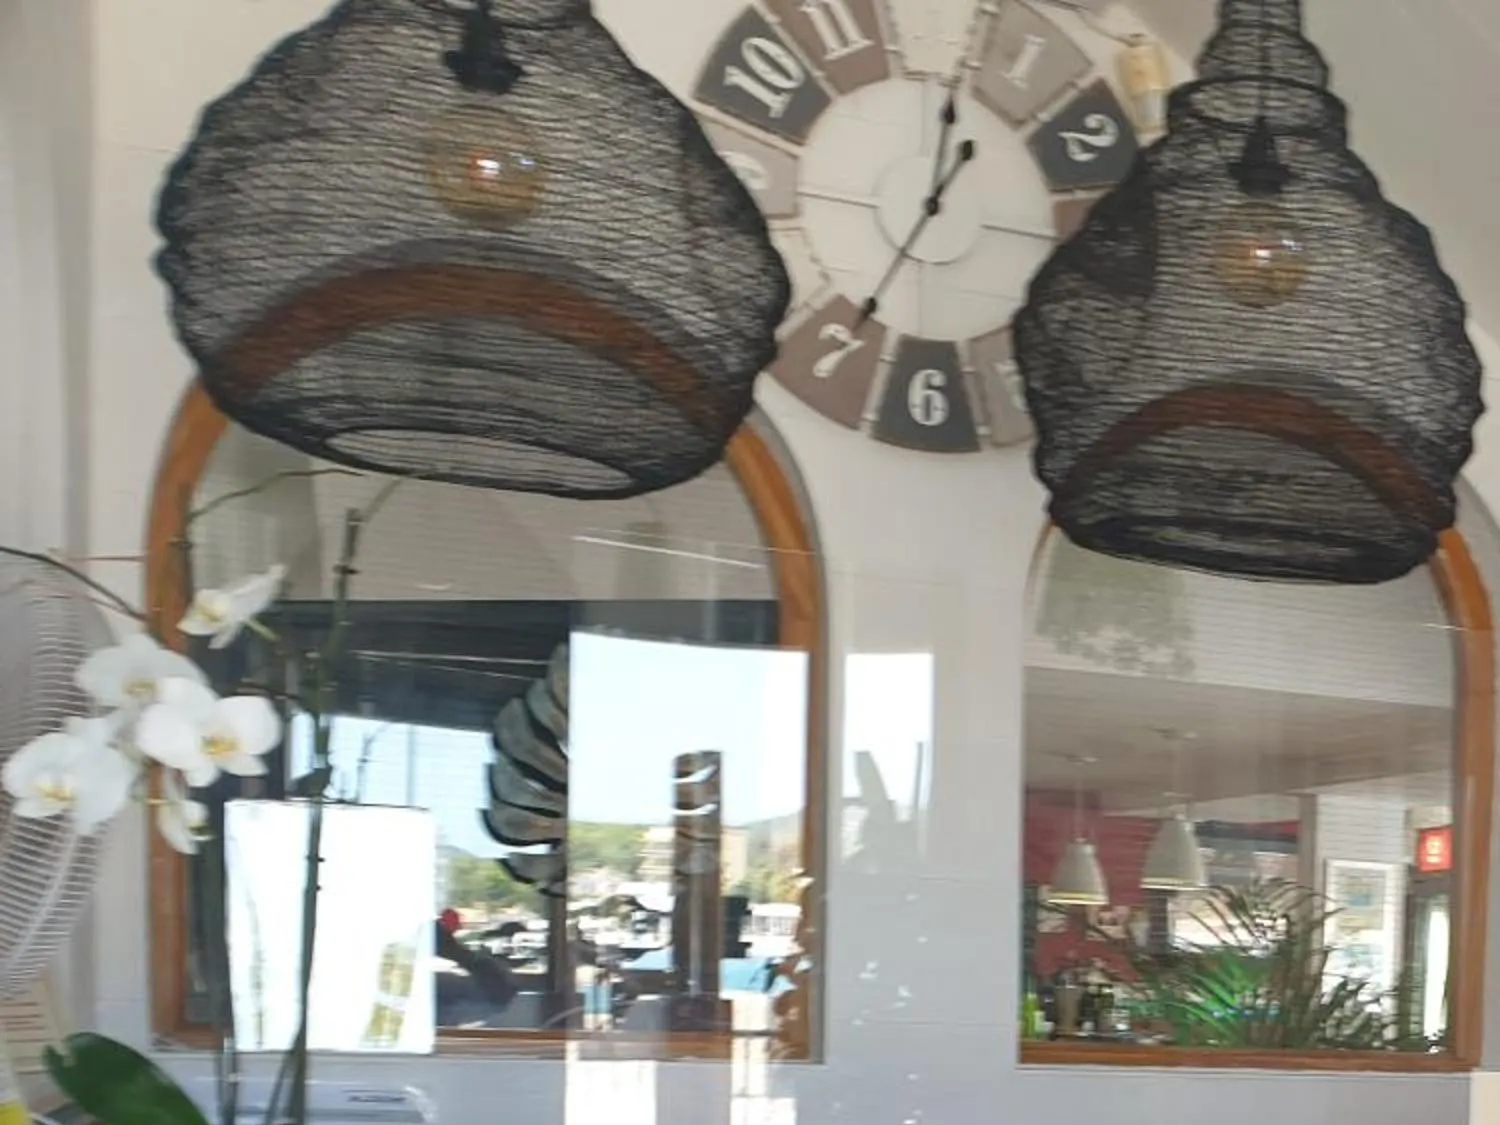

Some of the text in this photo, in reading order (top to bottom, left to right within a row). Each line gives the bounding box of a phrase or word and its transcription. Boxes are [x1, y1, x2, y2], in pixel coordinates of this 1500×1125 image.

[799, 0, 875, 60] 11
[723, 37, 804, 118] 10
[1005, 34, 1046, 88] 1
[1057, 114, 1120, 162] 2
[812, 323, 864, 378] 7
[907, 369, 950, 426] 6
